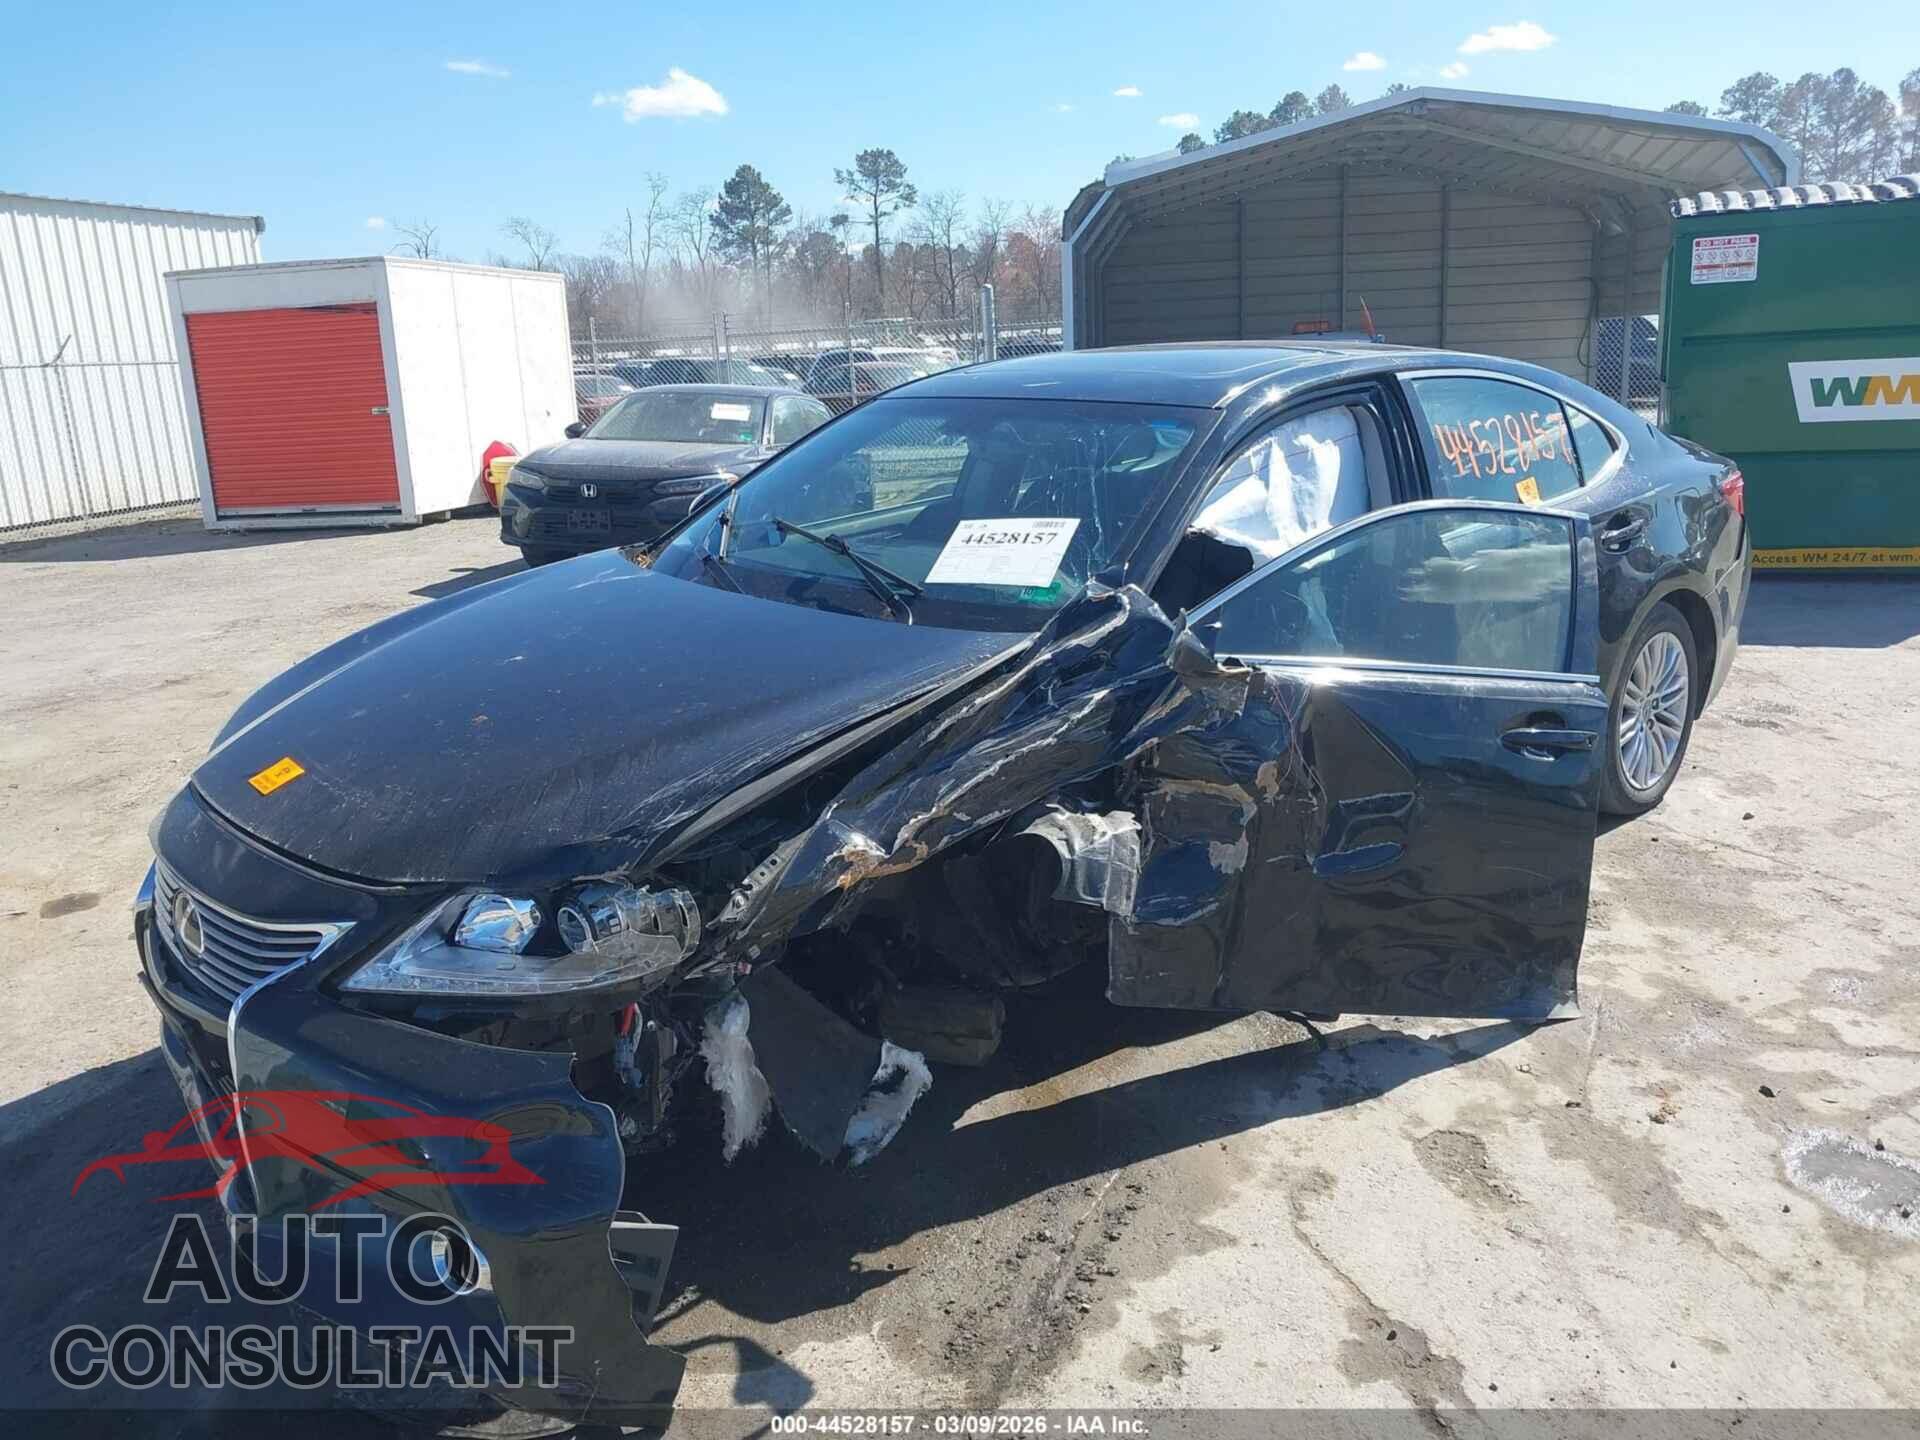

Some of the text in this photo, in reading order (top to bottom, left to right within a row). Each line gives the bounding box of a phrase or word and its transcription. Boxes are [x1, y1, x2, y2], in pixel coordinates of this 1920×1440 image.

[1810, 374, 1920, 407] WM
[1434, 410, 1573, 479] 44528157
[961, 532, 1057, 545] 44528157
[1752, 554, 1797, 564] Access
[1803, 552, 1827, 562] WM
[1832, 552, 1865, 562] 24/7
[1871, 552, 1884, 562] at
